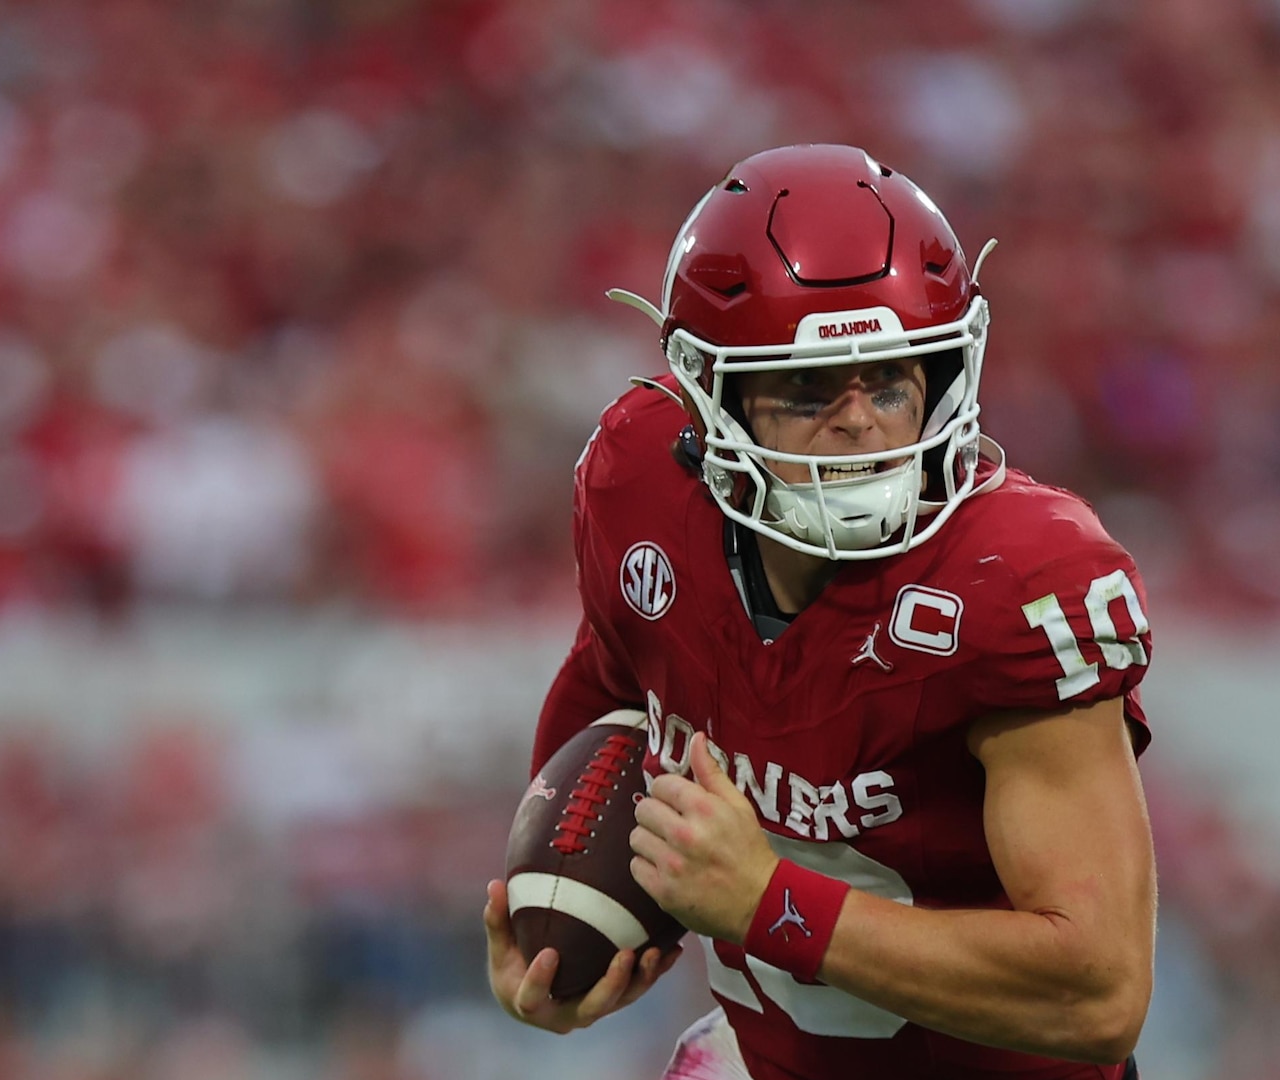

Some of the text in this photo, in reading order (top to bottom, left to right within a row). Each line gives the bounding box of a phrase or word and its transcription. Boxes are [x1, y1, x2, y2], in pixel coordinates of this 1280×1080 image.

[818, 318, 882, 339] OKLAHOMA
[625, 547, 672, 615] SEC
[893, 590, 958, 650] C
[1021, 569, 1149, 701] 10
